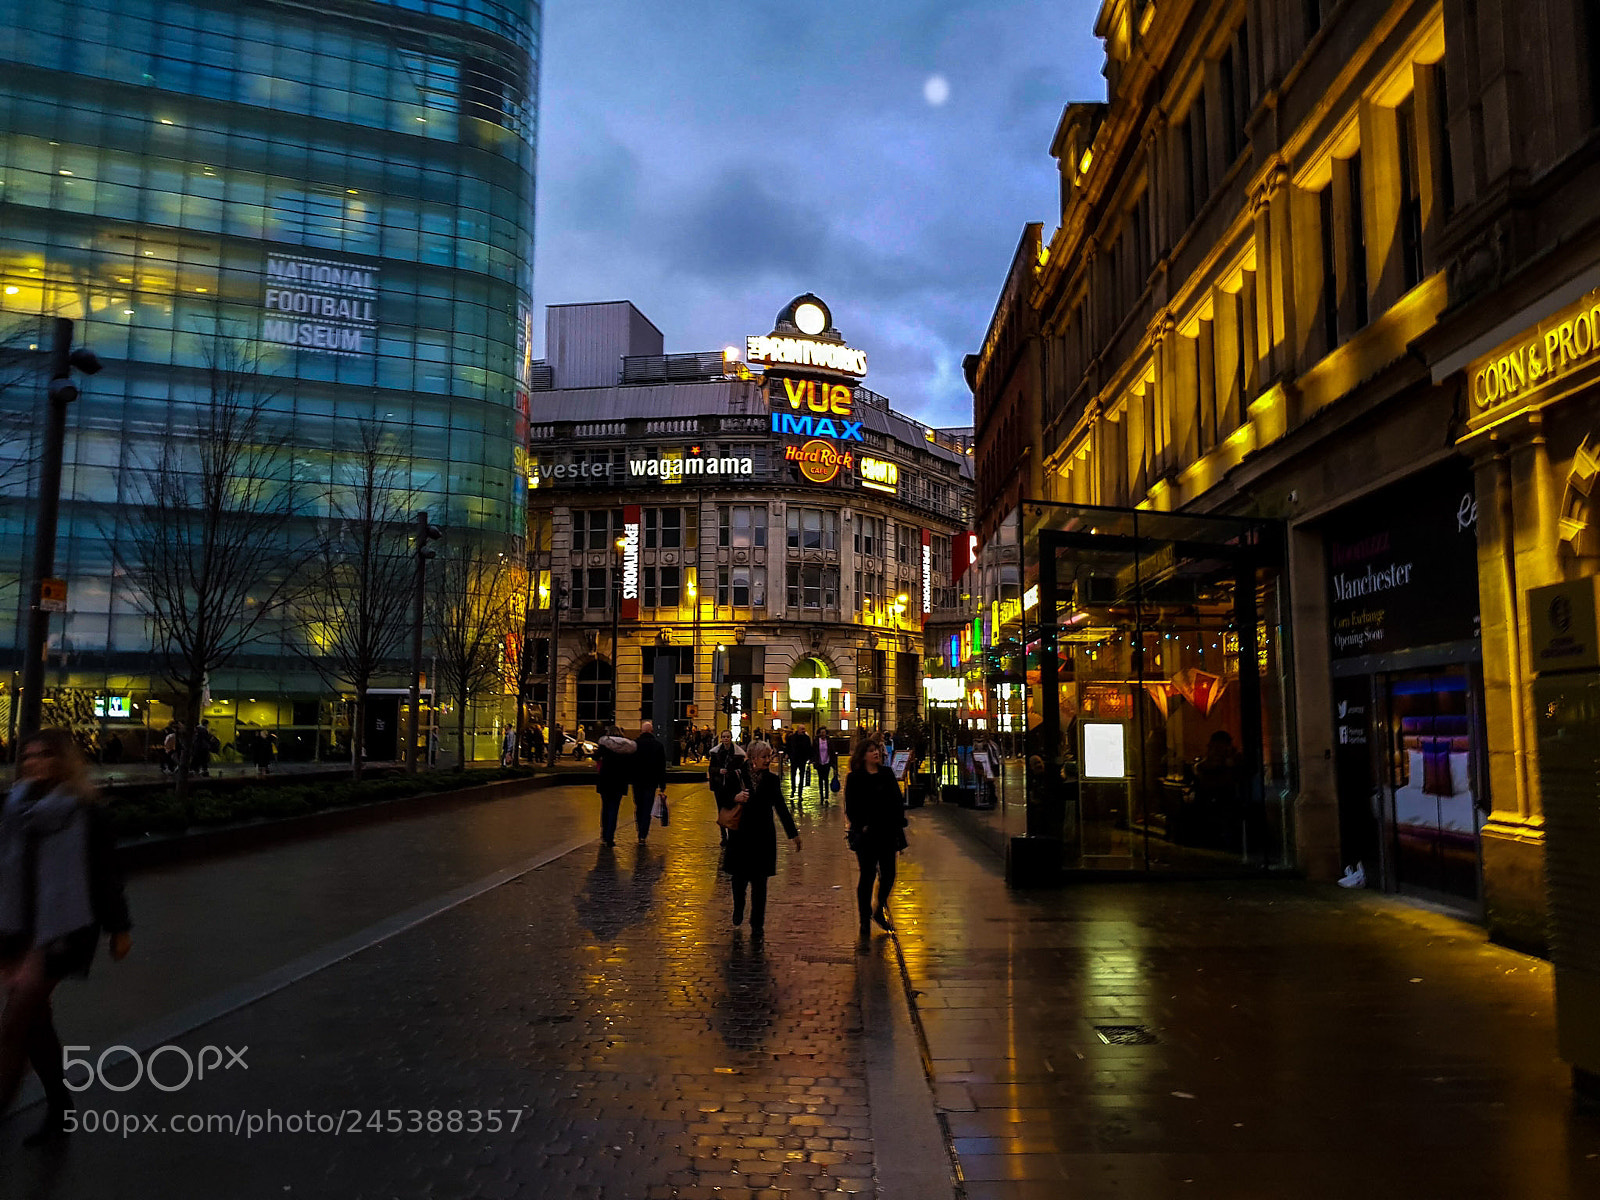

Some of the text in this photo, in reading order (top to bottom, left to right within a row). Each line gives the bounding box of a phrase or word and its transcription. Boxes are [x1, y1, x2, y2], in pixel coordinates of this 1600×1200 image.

[266, 258, 377, 293] NATIONAL
[264, 288, 377, 322] FOOTBALL
[263, 319, 361, 352] MUSEUM
[1474, 345, 1526, 408] CORN
[1528, 343, 1547, 380] &
[771, 411, 864, 442] IMAX
[630, 457, 753, 480] wagamama
[785, 445, 853, 469] Hard Rock
[1333, 561, 1413, 602] Manchester
[1334, 627, 1385, 652] Opening Soon
